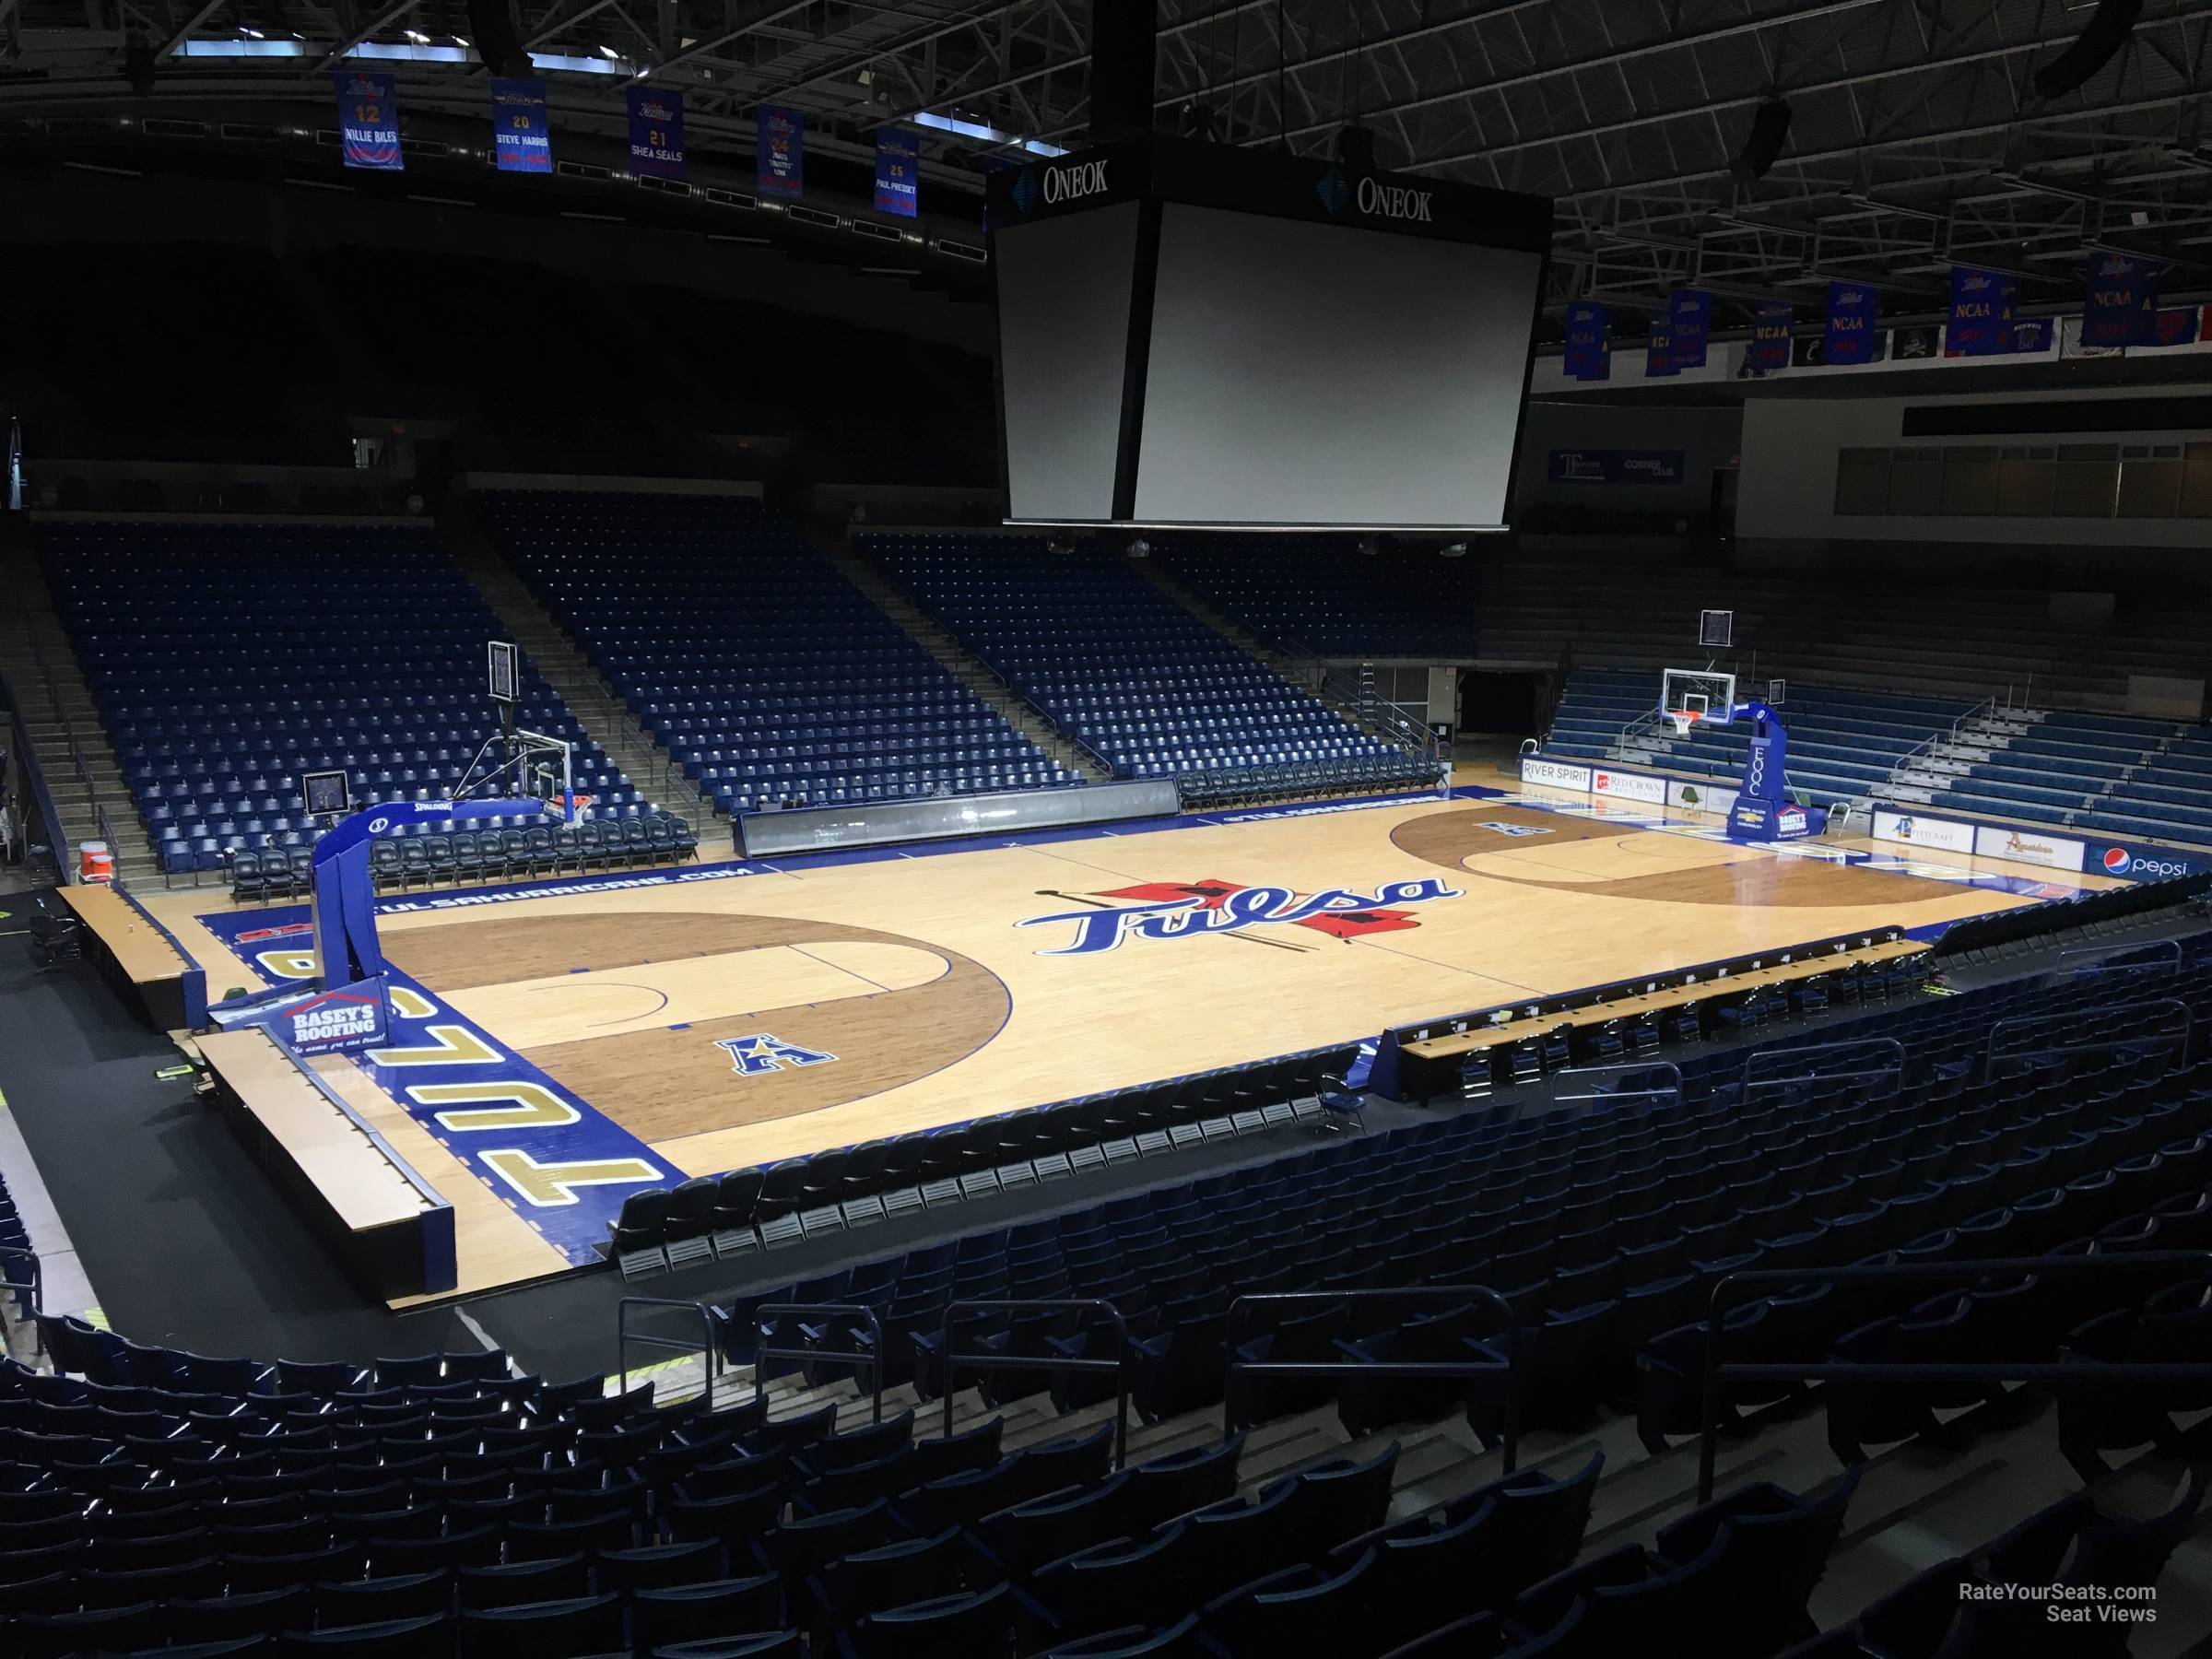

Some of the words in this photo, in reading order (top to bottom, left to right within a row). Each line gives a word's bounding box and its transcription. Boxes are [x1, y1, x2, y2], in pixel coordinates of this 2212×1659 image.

[356, 104, 379, 123] 12
[512, 115, 529, 128] 20
[374, 131, 397, 143] BILES
[496, 134, 520, 145] STEVE
[522, 135, 548, 147] HARRIS
[649, 130, 665, 147] 21
[630, 145, 654, 158] SHEA
[656, 149, 683, 162] SEALS
[890, 165, 903, 177] 25
[1043, 159, 1108, 204] ONEOK
[1357, 177, 1432, 221] ONEOK
[2094, 289, 2131, 306] NCAA
[1956, 302, 1991, 317] NCAA
[1832, 315, 1863, 330] NCAA
[1757, 325, 1788, 339] NCAA
[1624, 459, 1661, 469] CORNER
[1524, 763, 1555, 779] RIVER
[1557, 769, 1588, 782] SPIRIT
[1611, 776, 1629, 788] RED
[1630, 779, 1661, 793] CROWN
[415, 802, 453, 812] SPALDING
[2132, 858, 2188, 877] pepsi
[373, 867, 754, 915] ULSAHURRICANE.COM
[1013, 877, 1466, 957] Tulsa
[293, 1005, 374, 1030] BASEY'S
[295, 1018, 375, 1042] ROOFING
[305, 1044, 327, 1053] name
